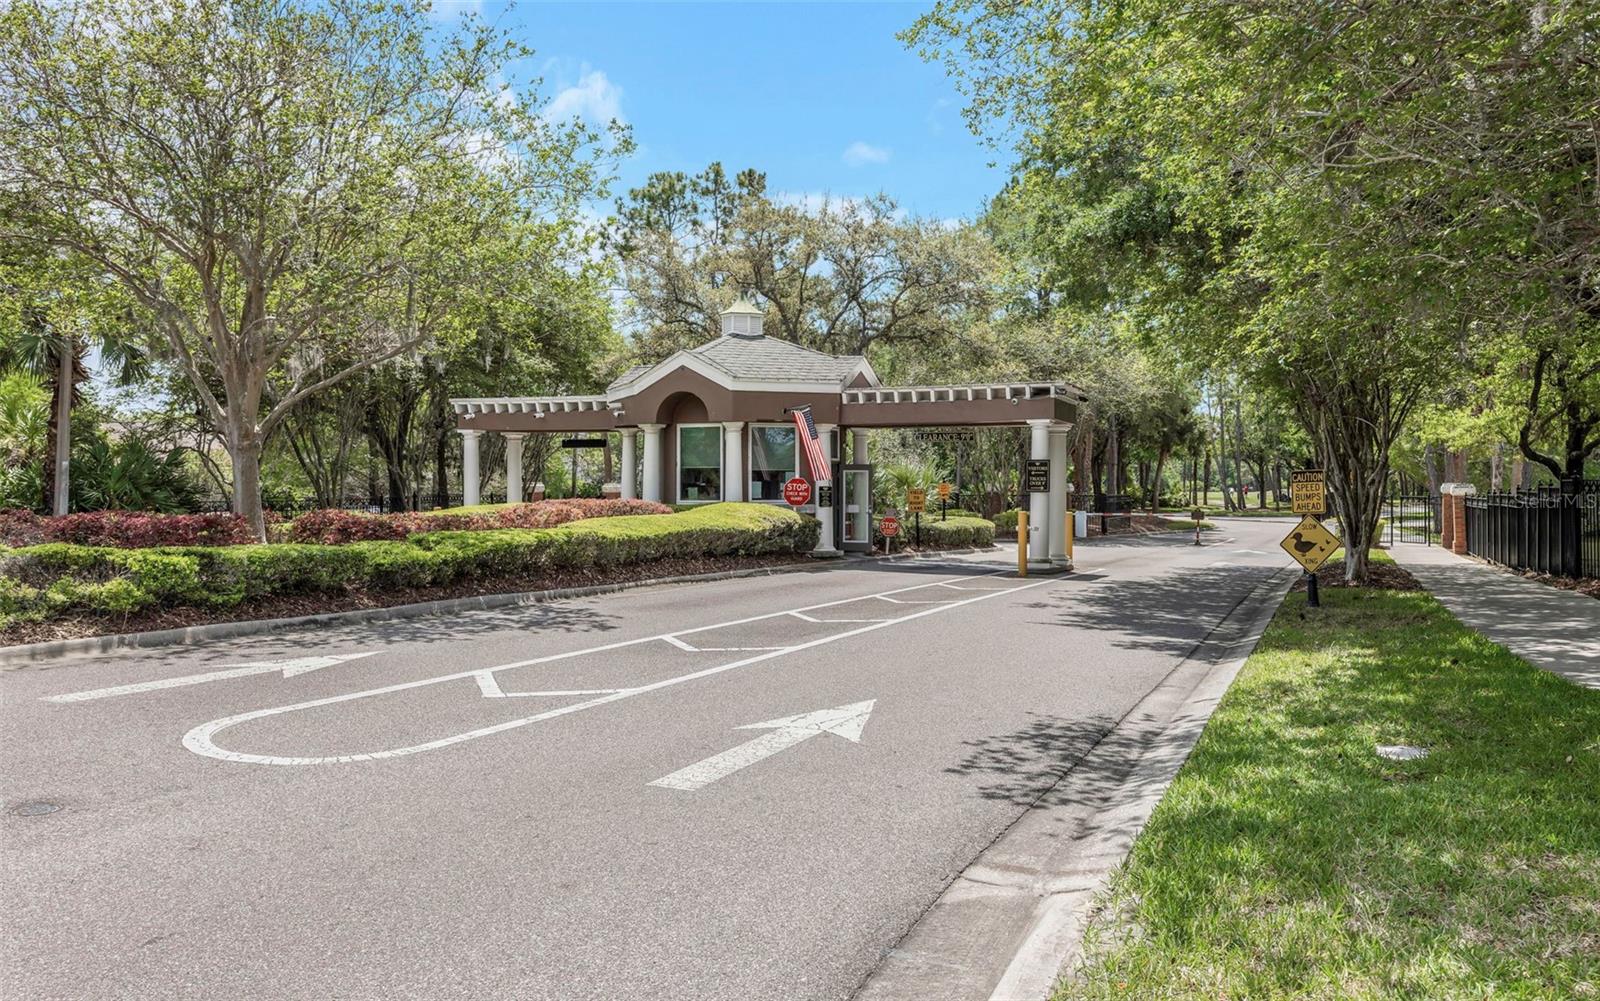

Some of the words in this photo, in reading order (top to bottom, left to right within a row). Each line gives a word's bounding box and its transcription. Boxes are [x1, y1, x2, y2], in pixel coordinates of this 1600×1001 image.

[1292, 472, 1323, 482] CAUTION
[786, 483, 808, 491] STOP
[1295, 483, 1321, 492] SPEED
[1295, 493, 1322, 502] BUMPS
[1296, 502, 1322, 511] AHEAD
[1301, 523, 1318, 531] SLOW
[1304, 557, 1319, 565] XING
